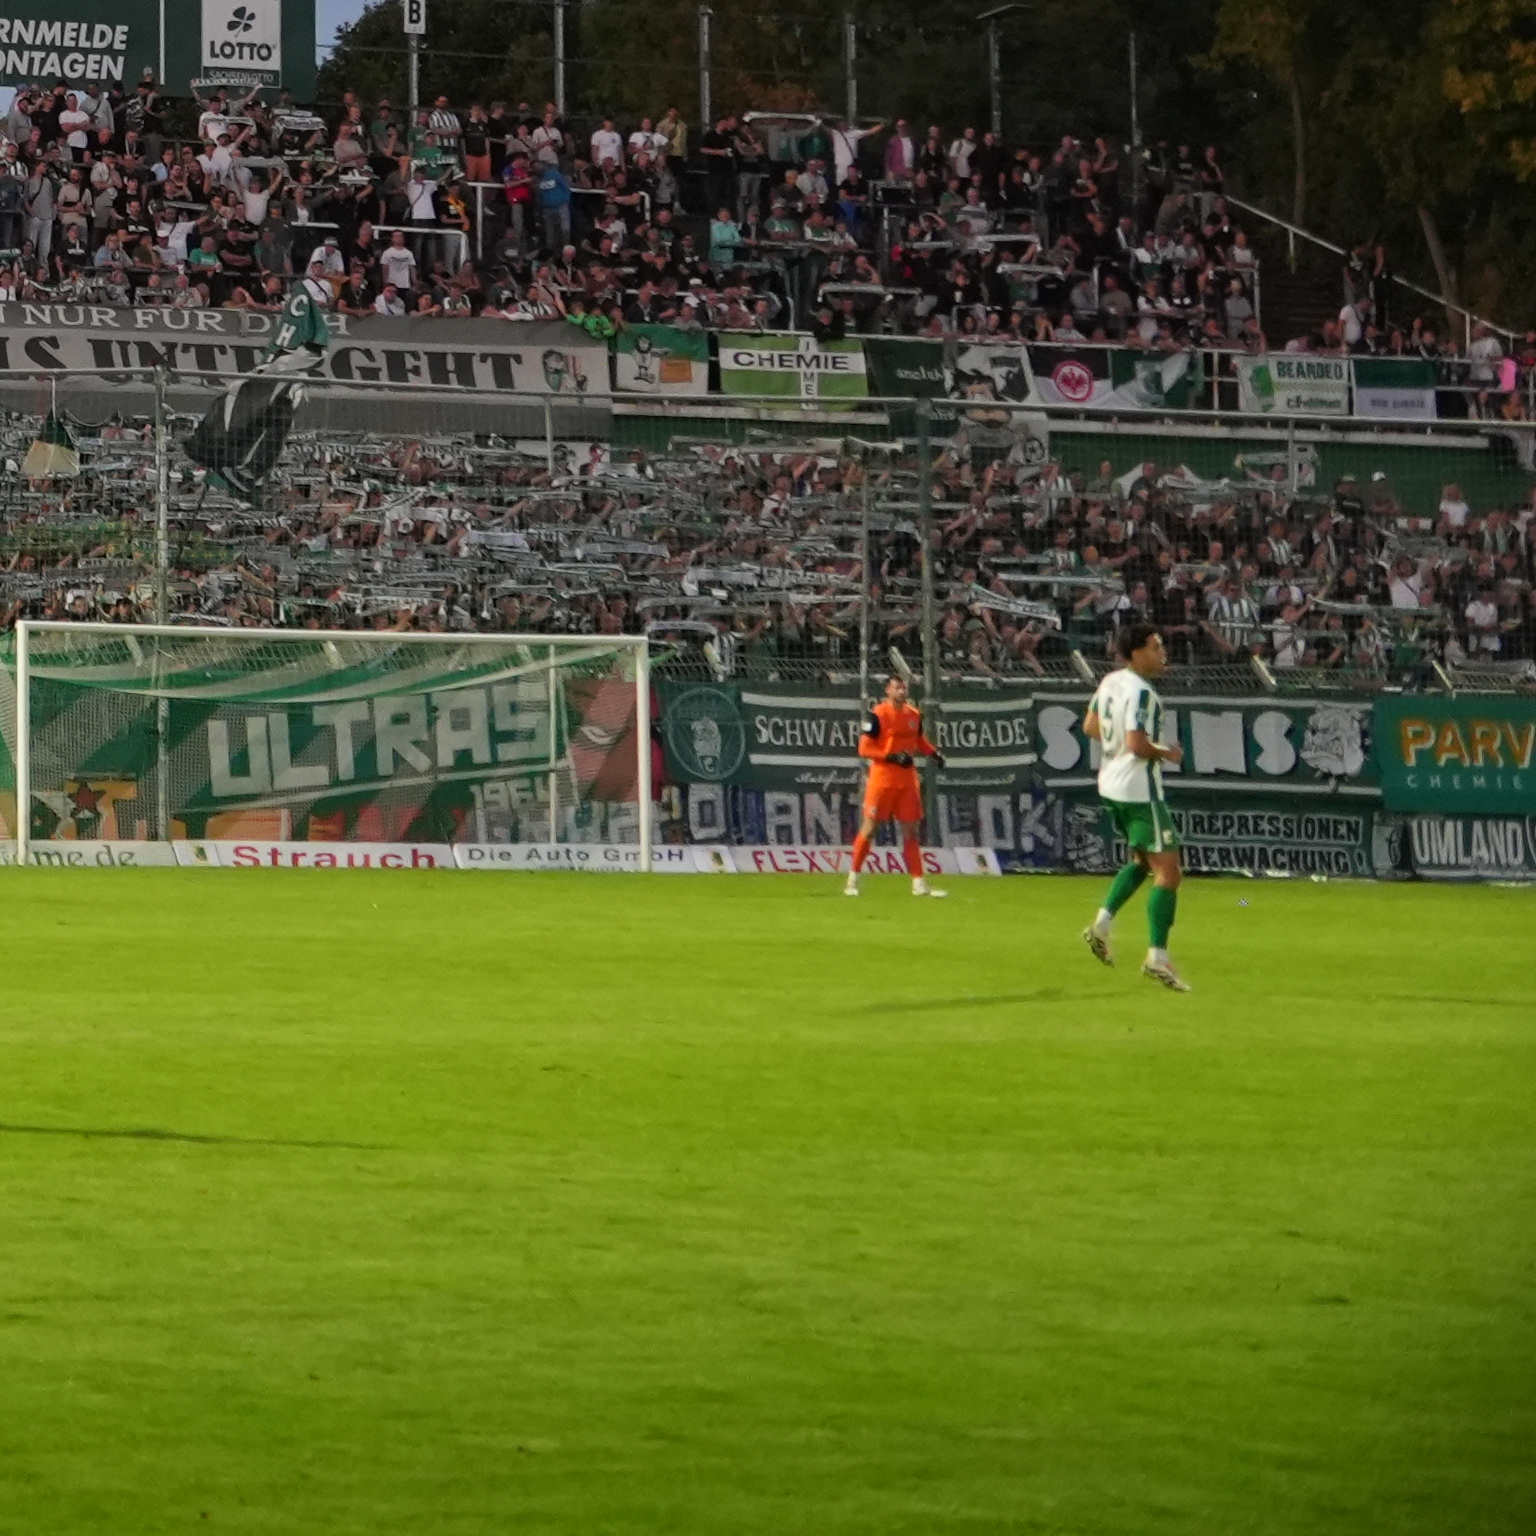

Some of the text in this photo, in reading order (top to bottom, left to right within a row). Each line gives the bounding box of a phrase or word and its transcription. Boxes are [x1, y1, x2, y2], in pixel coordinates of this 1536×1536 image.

[409, 0, 421, 23] B
[210, 40, 273, 62] LOTTO
[22, 303, 117, 327] NUR
[87, 338, 524, 390] UNTEGEHT
[733, 352, 850, 370] CHEMIE
[207, 681, 551, 798] ULTRAS
[754, 715, 1030, 749] SCHWAR RIGADE
[1406, 773, 1523, 791] CHEMIE
[1188, 810, 1362, 843] REPRESSIONEN
[1411, 819, 1525, 865] UMLAND
[232, 845, 436, 869] Strauch
[468, 848, 513, 862] Die
[524, 847, 590, 862] Auto
[1178, 843, 1348, 873] BERWACHUNG
